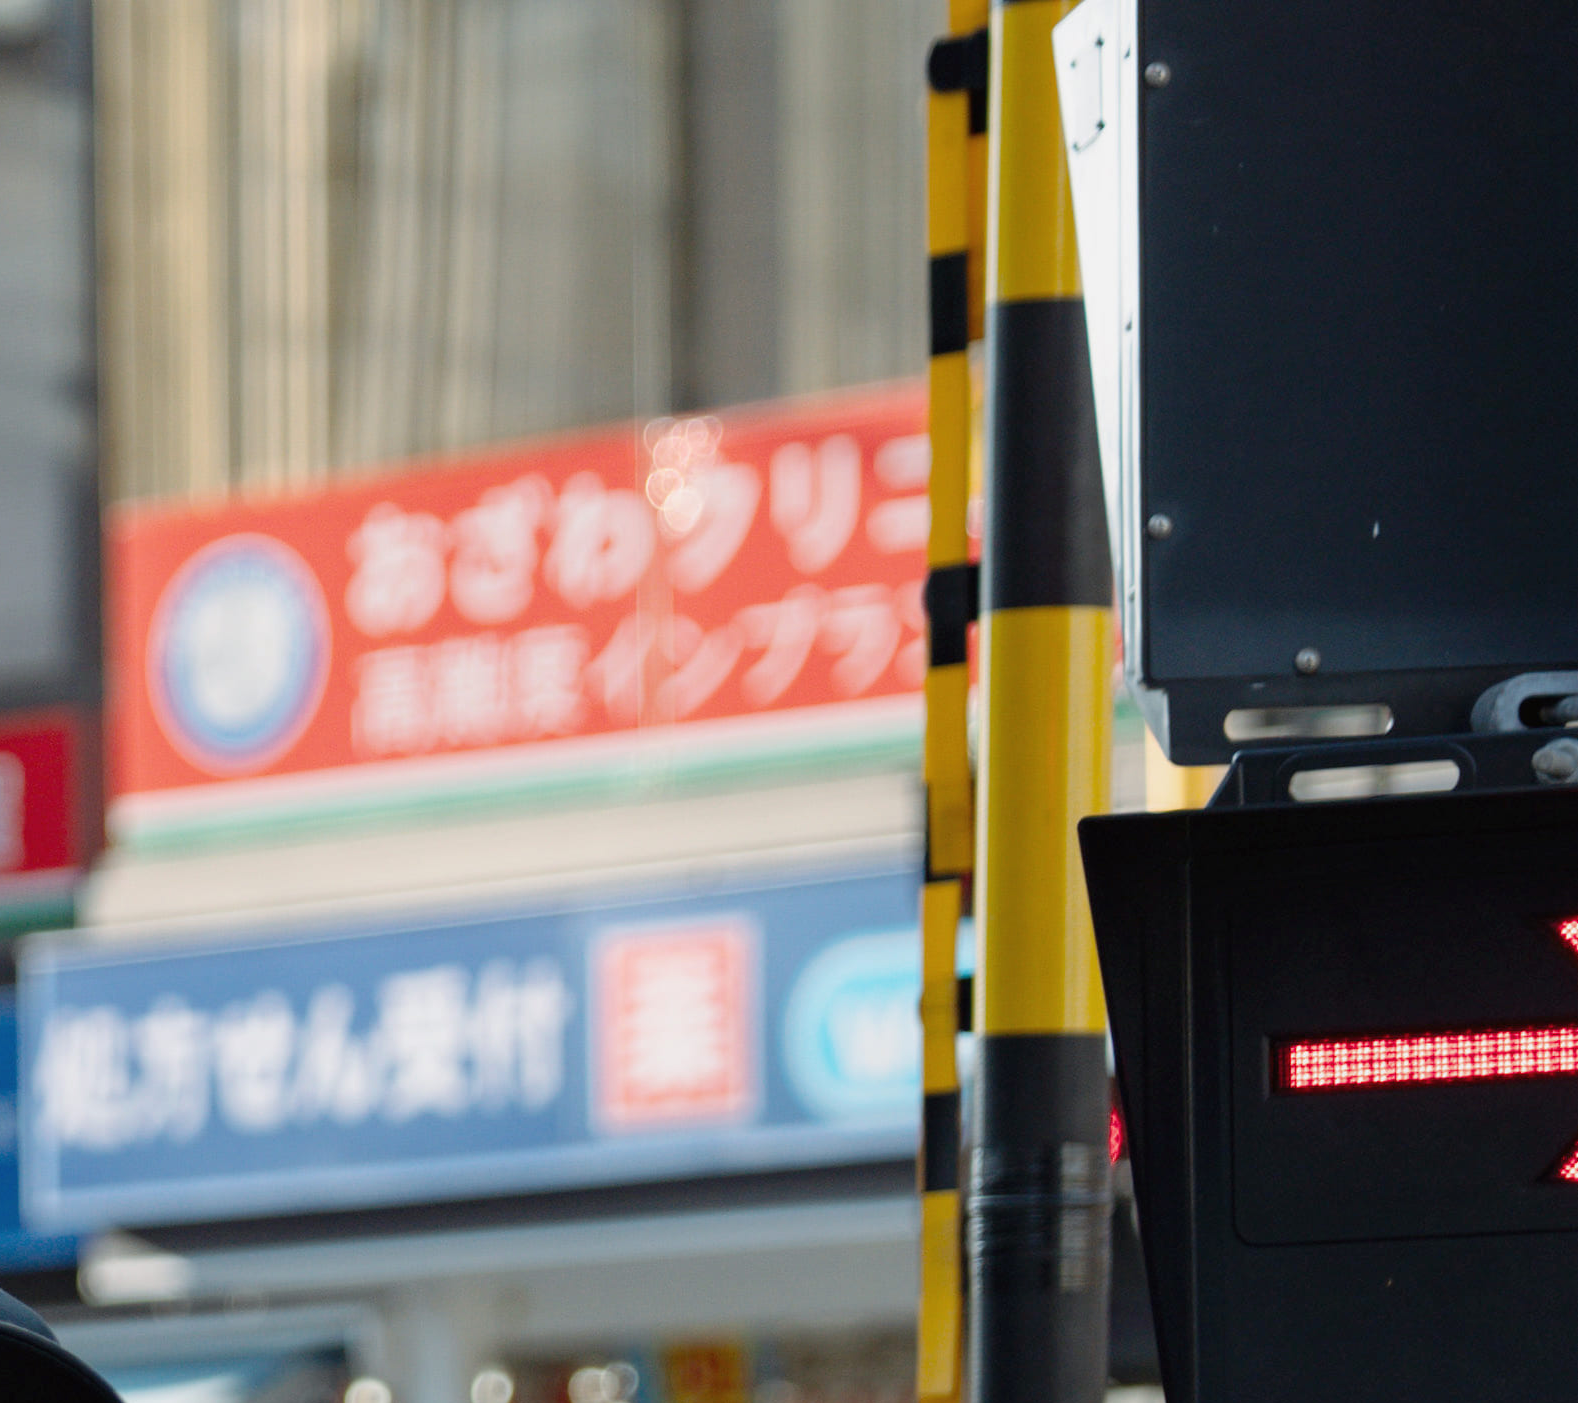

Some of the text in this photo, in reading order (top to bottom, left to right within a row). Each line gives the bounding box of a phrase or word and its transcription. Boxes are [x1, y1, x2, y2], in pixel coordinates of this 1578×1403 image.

[38, 960, 571, 1149] 処方せん受付
